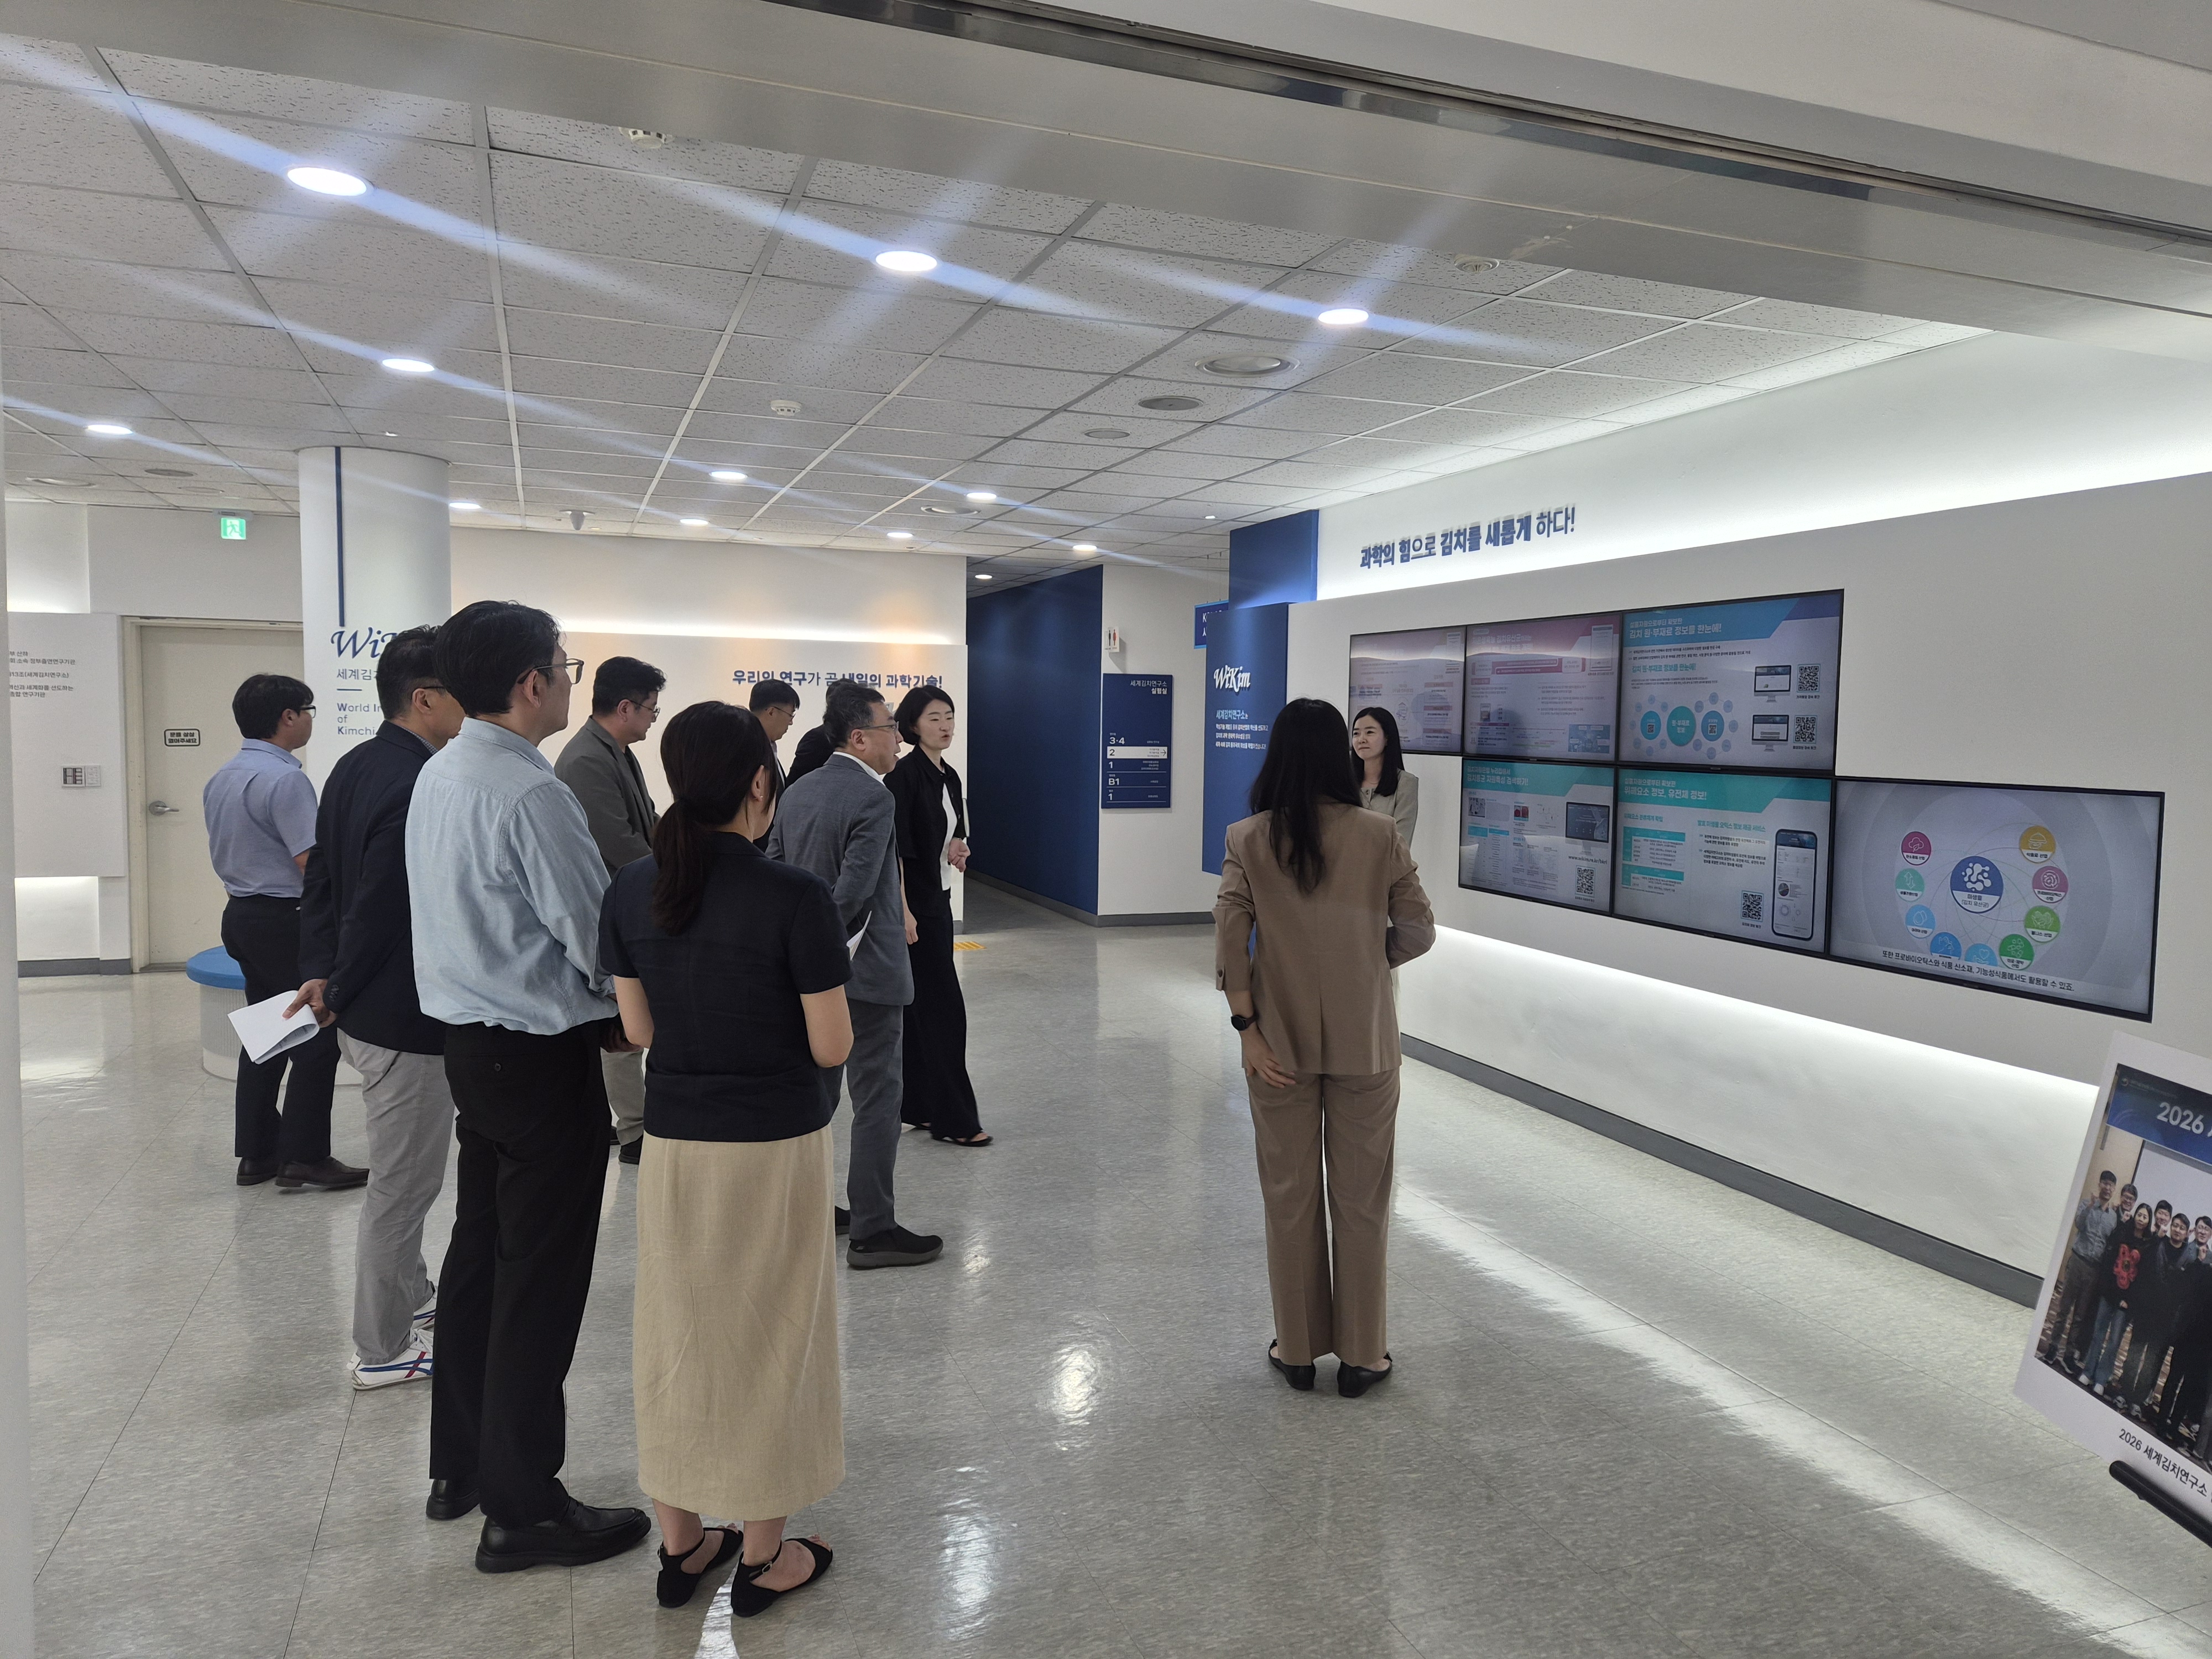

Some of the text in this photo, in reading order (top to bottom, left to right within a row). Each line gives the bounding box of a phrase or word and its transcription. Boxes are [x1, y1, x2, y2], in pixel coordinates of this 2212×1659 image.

[1360, 507, 1575, 568] 과학의 힘으로 김치를 새롭게 하다!
[1630, 630, 1642, 639] 김치
[1674, 625, 1695, 635] 정보를
[1697, 623, 1721, 634] 한눈에!
[780, 671, 821, 686] 연구가
[886, 675, 942, 688] 과학기술!
[1214, 665, 1251, 692] WiKim
[337, 703, 369, 712] World
[1216, 709, 1249, 720] 세계김치연구소는
[338, 726, 375, 735] Kimchi
[1651, 787, 1666, 798] 정보,
[1668, 789, 1688, 799] 유전체
[1690, 790, 1707, 800] 정보!
[1882, 950, 1893, 958] 또한
[1895, 952, 1940, 967] 프로바이오틱스와
[1941, 961, 1953, 969] 식품
[1954, 964, 1975, 974] 신소재,
[1976, 967, 2027, 983] 기능성식품에서도
[2028, 976, 2048, 987] 활용할
[2059, 982, 2075, 992] 있죠.
[2157, 1102, 2204, 1134] 2026
[2119, 1428, 2207, 1497] 2026 세계김치연구소
